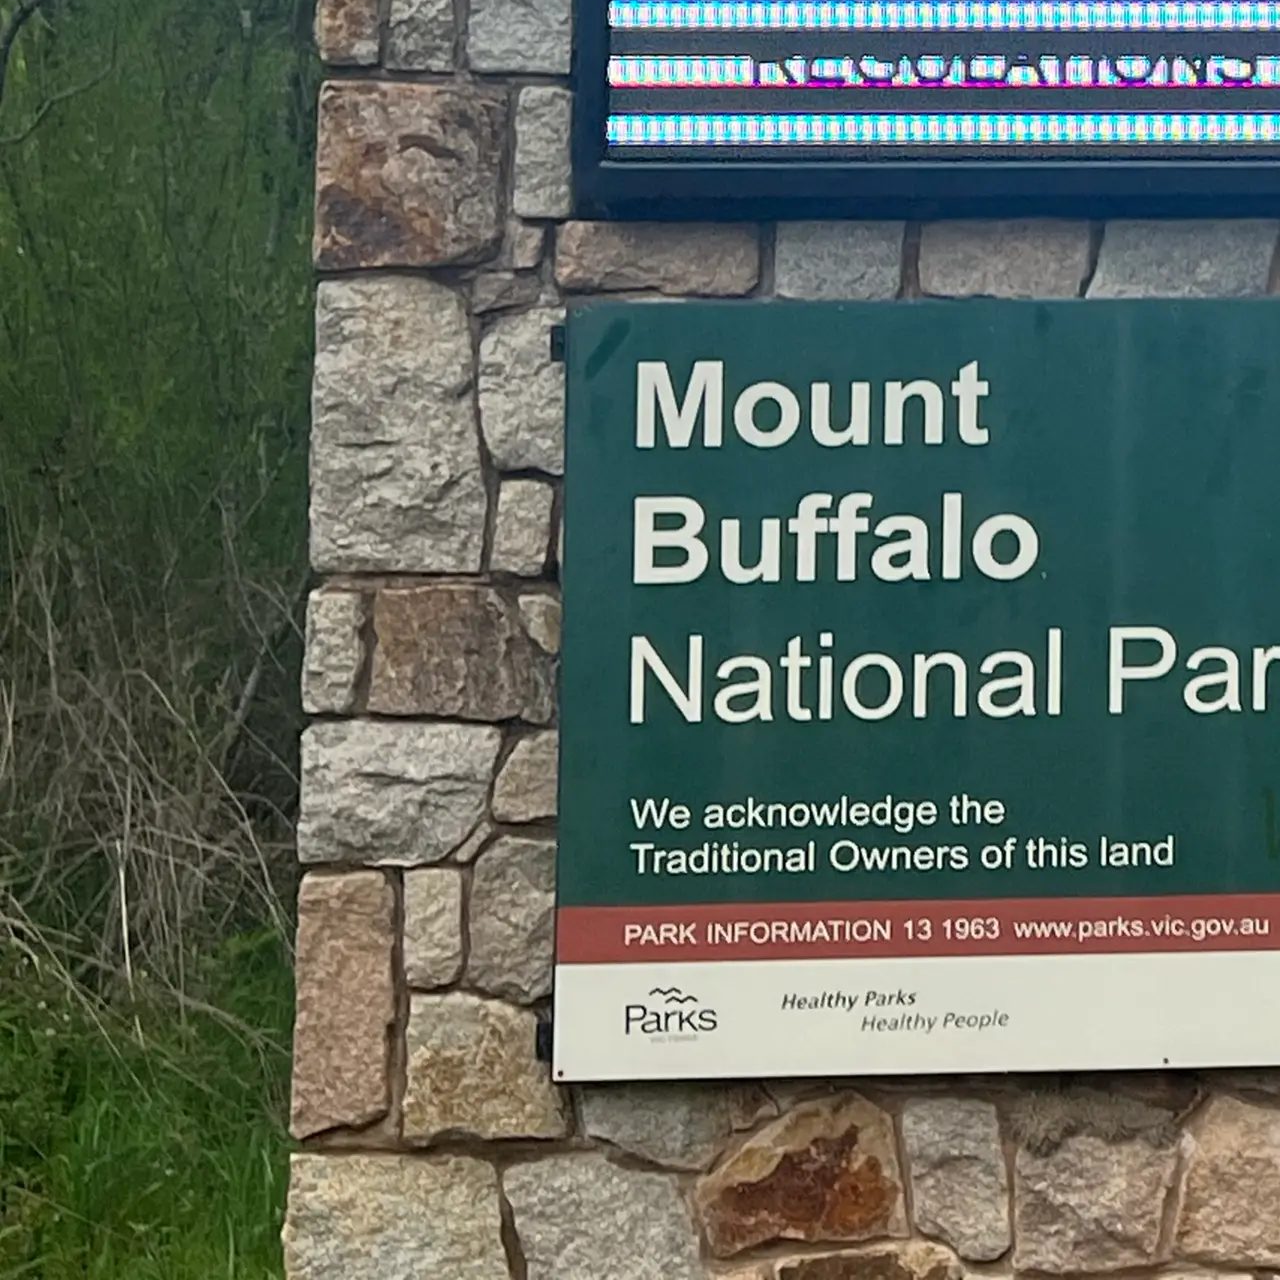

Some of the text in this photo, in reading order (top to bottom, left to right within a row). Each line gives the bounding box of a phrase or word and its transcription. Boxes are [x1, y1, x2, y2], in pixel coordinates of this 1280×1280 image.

[635, 360, 990, 449] Mount
[632, 492, 1040, 585] Buffalo
[629, 628, 1062, 724] National
[630, 794, 1005, 834] We acknowledge the
[629, 835, 1175, 875] Traditional Owners of this land
[624, 914, 1270, 947] PARK INFORMATION 13 1963 www.parks.vic.gov.au
[624, 1004, 718, 1035] Parks
[781, 989, 918, 1011] Healthy Parks
[860, 1010, 1010, 1033] Healthy People
